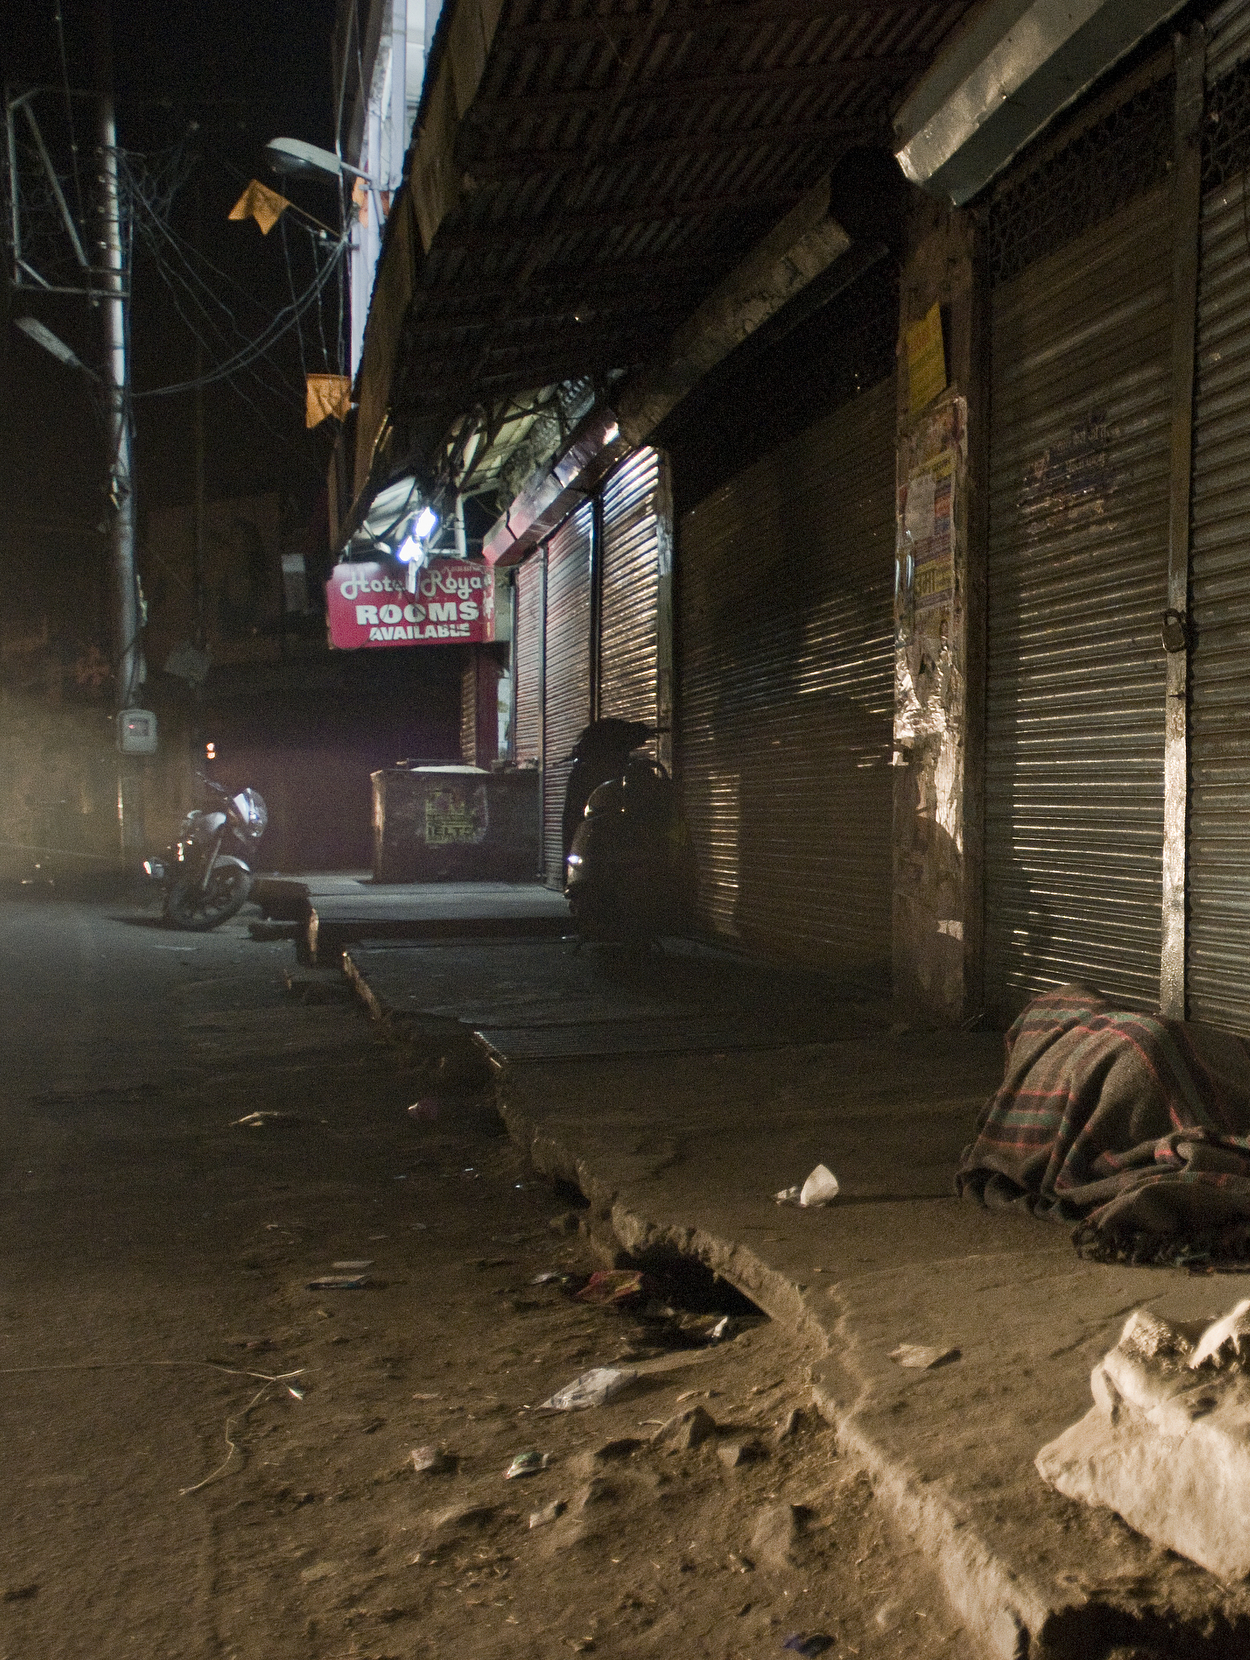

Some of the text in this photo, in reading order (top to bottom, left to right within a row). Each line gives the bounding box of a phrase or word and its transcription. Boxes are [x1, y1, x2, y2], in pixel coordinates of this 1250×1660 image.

[340, 569, 408, 600] Hote
[355, 601, 480, 625] ROOMS
[369, 623, 471, 642] AVAILABLE
